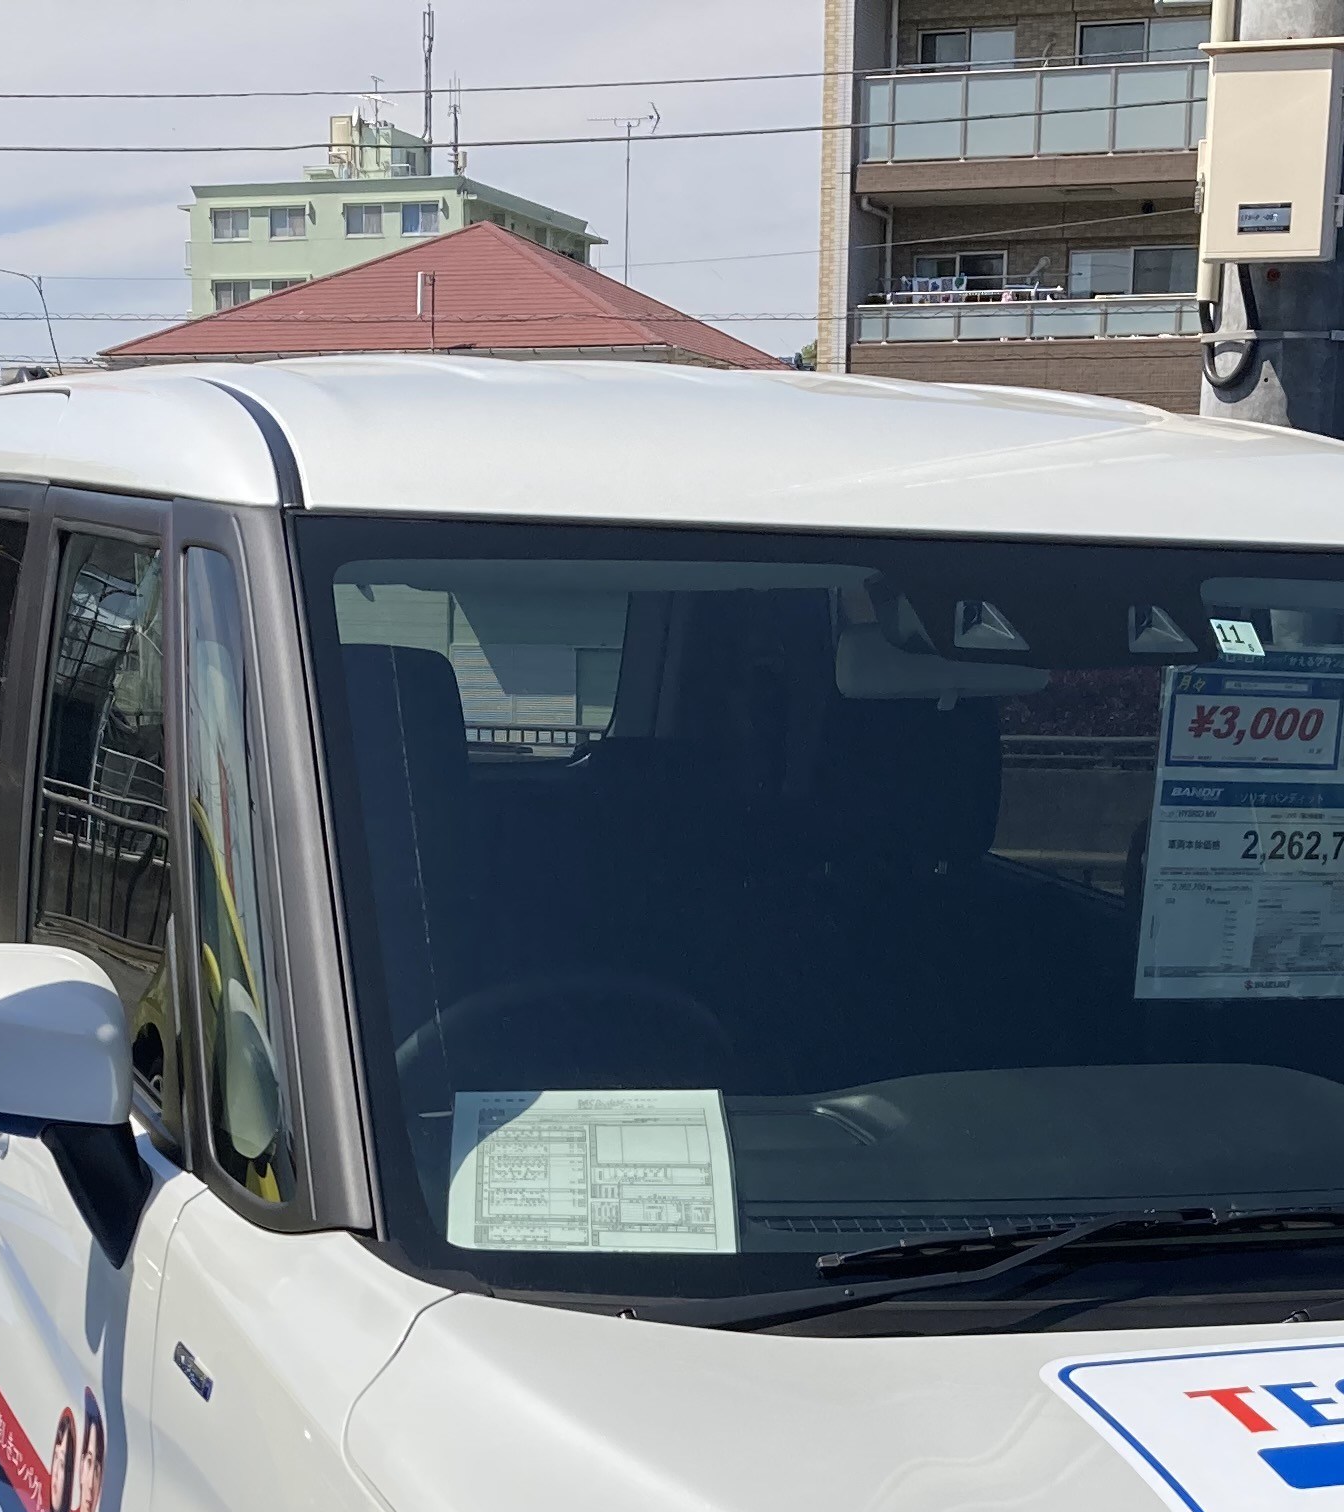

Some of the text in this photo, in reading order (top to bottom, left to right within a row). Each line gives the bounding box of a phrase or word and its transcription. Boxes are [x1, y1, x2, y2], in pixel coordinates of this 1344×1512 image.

[1216, 623, 1245, 645] 11
[1188, 705, 1325, 745] ¥3,000
[1170, 786, 1225, 799] BANDIT
